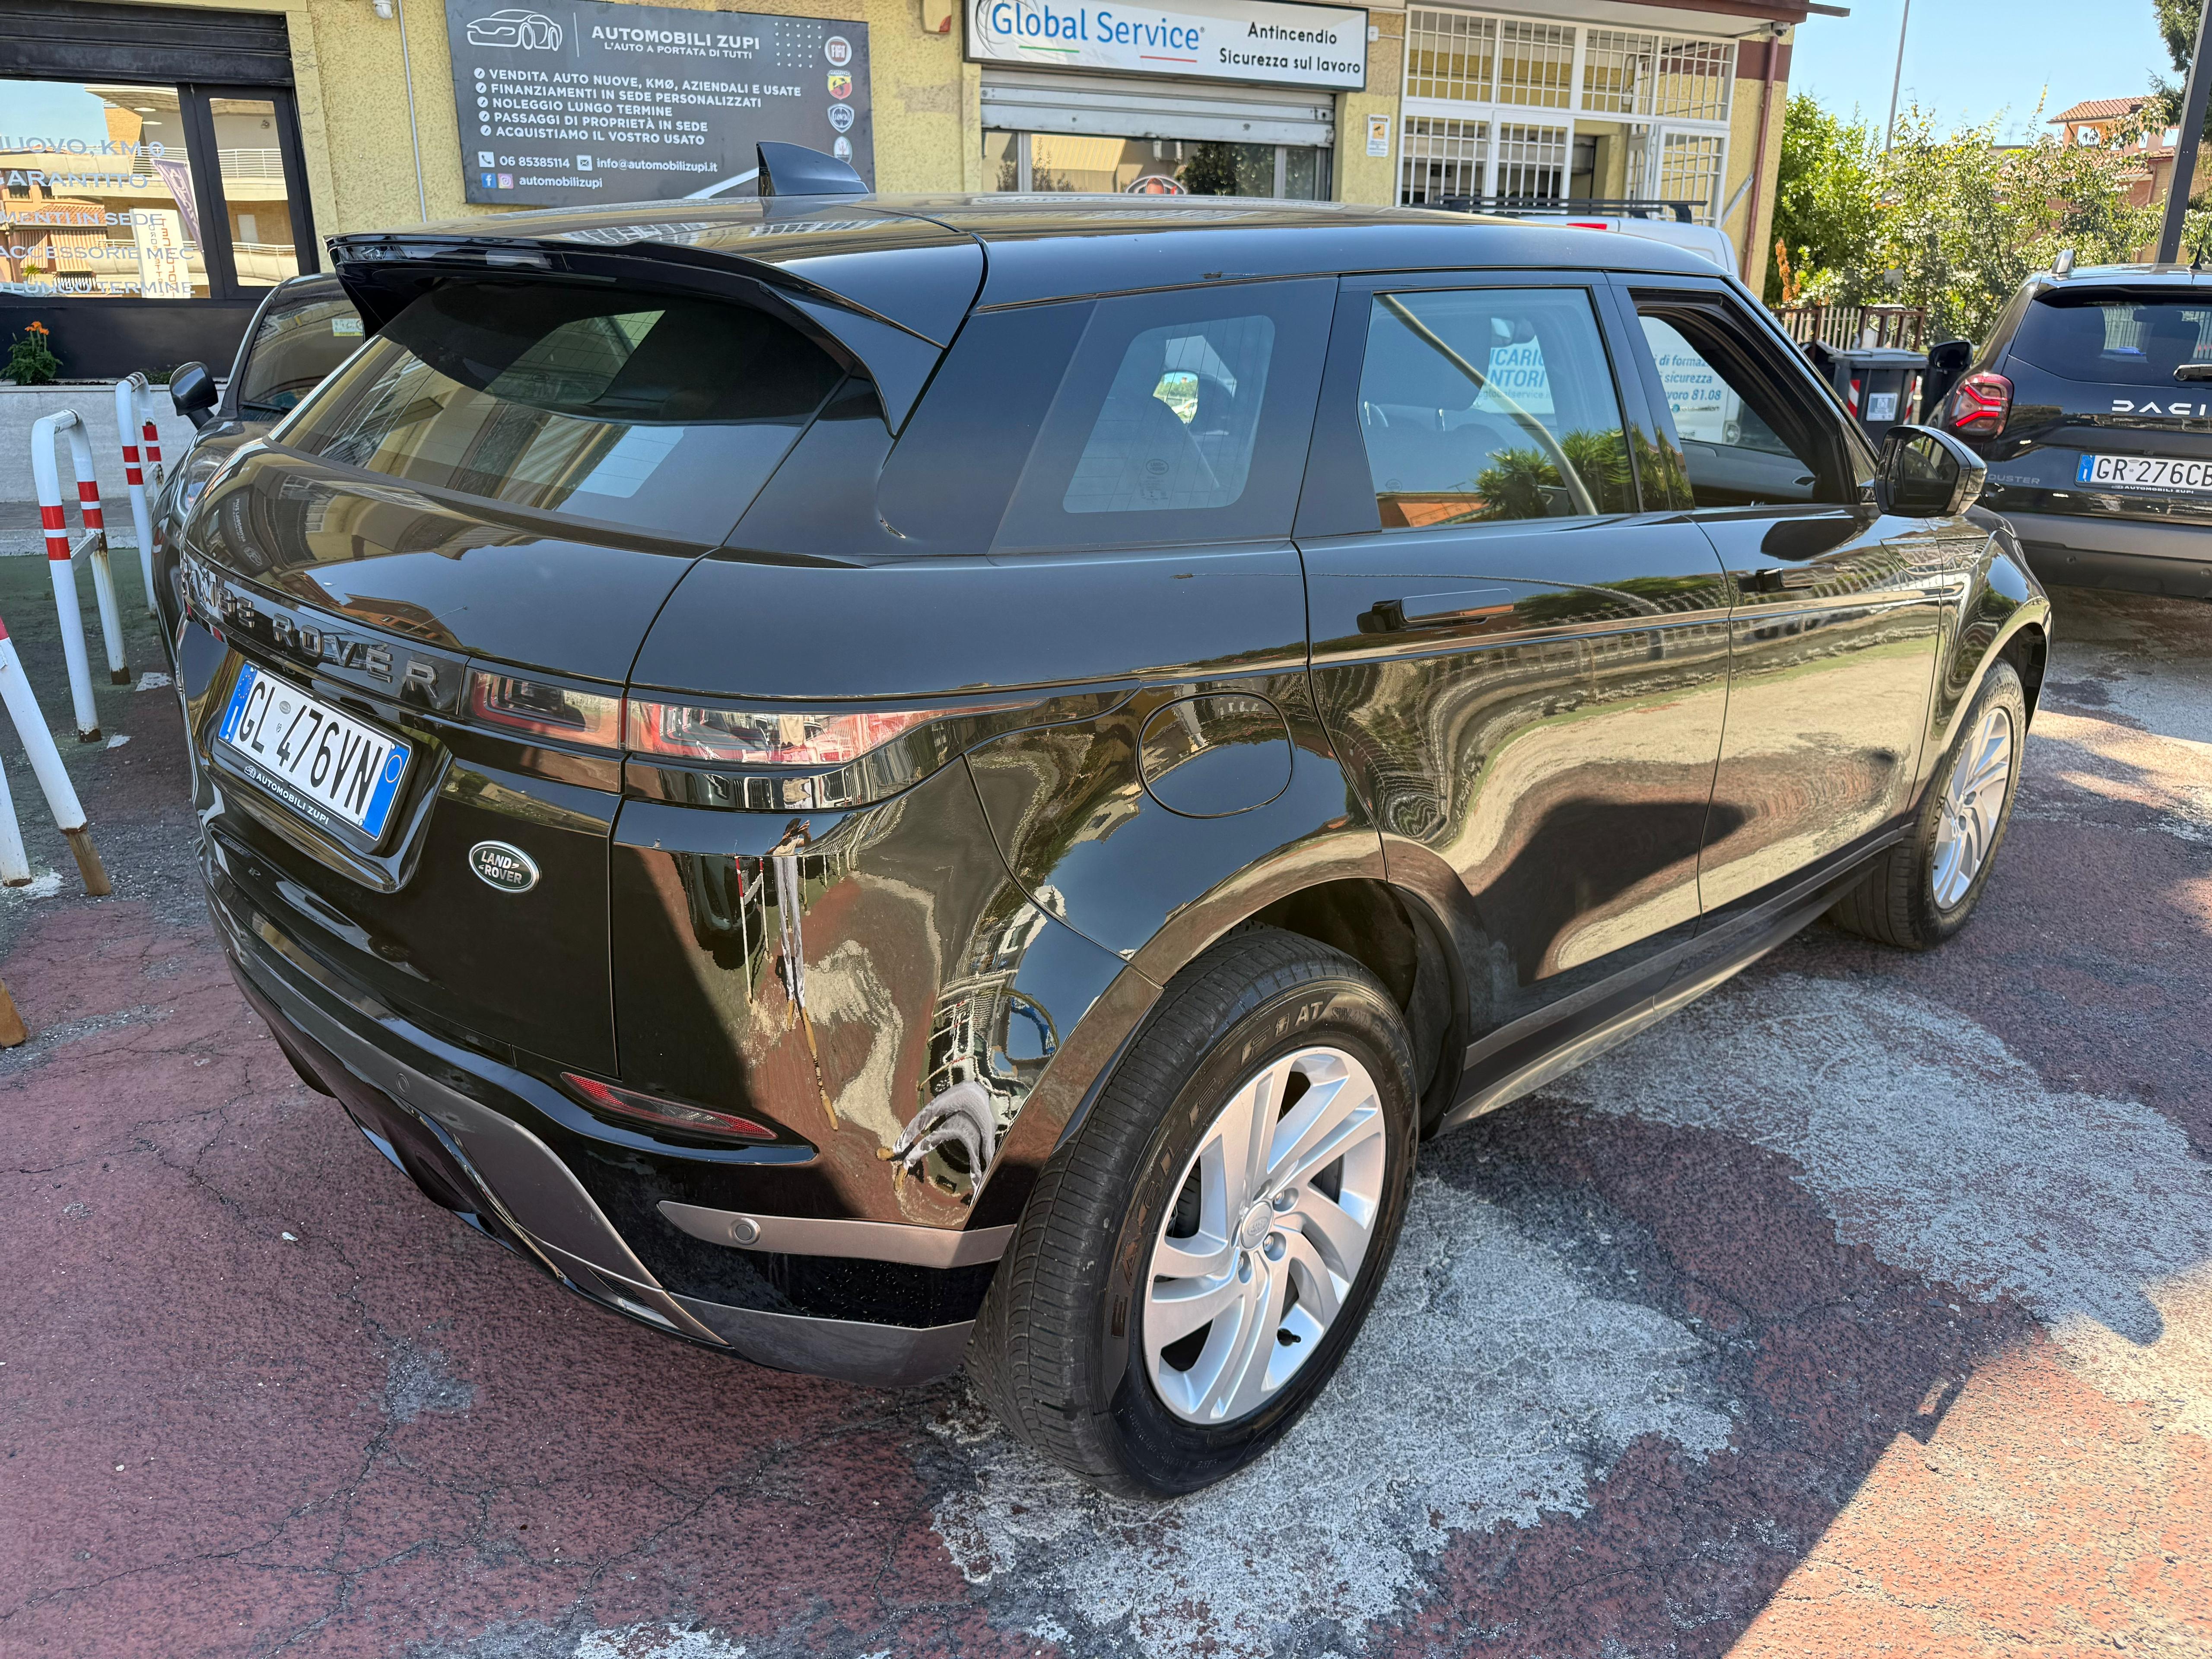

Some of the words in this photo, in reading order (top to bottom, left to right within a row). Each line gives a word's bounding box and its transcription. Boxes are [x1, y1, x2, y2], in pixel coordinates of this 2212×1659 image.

[993, 3, 1088, 41] Global
[591, 26, 711, 47] AUTOMOBILI
[716, 35, 760, 50] ZUPI
[1248, 22, 1337, 44] Antincendio
[604, 42, 644, 52] L'AUTO
[657, 46, 706, 57] PORTATA
[709, 49, 720, 57] DI
[722, 50, 752, 59] TUTTI
[1220, 48, 1288, 68] Sicurezza
[1294, 56, 1312, 70] sul
[1317, 57, 1360, 73] lavoro
[489, 69, 549, 83] VENDITA
[553, 73, 589, 85] AUTO
[593, 75, 642, 89] NUOVE,
[681, 80, 749, 94] AZIENDALI
[752, 84, 760, 94] E
[763, 85, 801, 97] USATE
[491, 83, 597, 99] FINANZIAMENTI
[601, 89, 615, 100] IN
[619, 90, 652, 102] SEDE
[655, 93, 761, 108] PERSONALIZZATI
[493, 98, 563, 111] NOLEGGIO
[567, 102, 613, 114] LUNGO
[617, 104, 673, 117] TERMINE
[494, 112, 560, 125] PASSAGGI
[564, 115, 578, 126] DI
[582, 116, 655, 130] PROPRIETÀ
[658, 120, 672, 130] IN
[675, 121, 708, 132] SEDE
[496, 126, 588, 140] ACQUISTIAMO
[592, 130, 605, 141] IL
[608, 131, 660, 143] VOSTRO
[664, 134, 705, 146] USATO
[100, 139, 143, 157] KM
[499, 156, 516, 166] 06
[518, 156, 571, 168] 85385114
[596, 158, 718, 173] info@automobilizupi.it
[518, 176, 603, 190] automobilizupi
[76, 212, 100, 225] IN
[106, 213, 162, 226] SEDE
[10, 281, 91, 294] LUNGO
[97, 281, 193, 295] TERMINE
[1665, 371, 1713, 384] sicurezza
[1691, 389, 1722, 400] 81.08
[1988, 474, 2040, 484] DUSTER
[2096, 458, 2128, 481] GR
[2136, 461, 2212, 487] 276CB
[273, 613, 441, 706] ROVER
[239, 681, 276, 755] GL
[276, 704, 384, 816] 476VN
[256, 772, 307, 812] AUTOMOBILI
[306, 806, 330, 825] ZUPI
[481, 850, 512, 869] LAND
[484, 864, 522, 884] ROVER
[1294, 1001, 1324, 1027] AT
